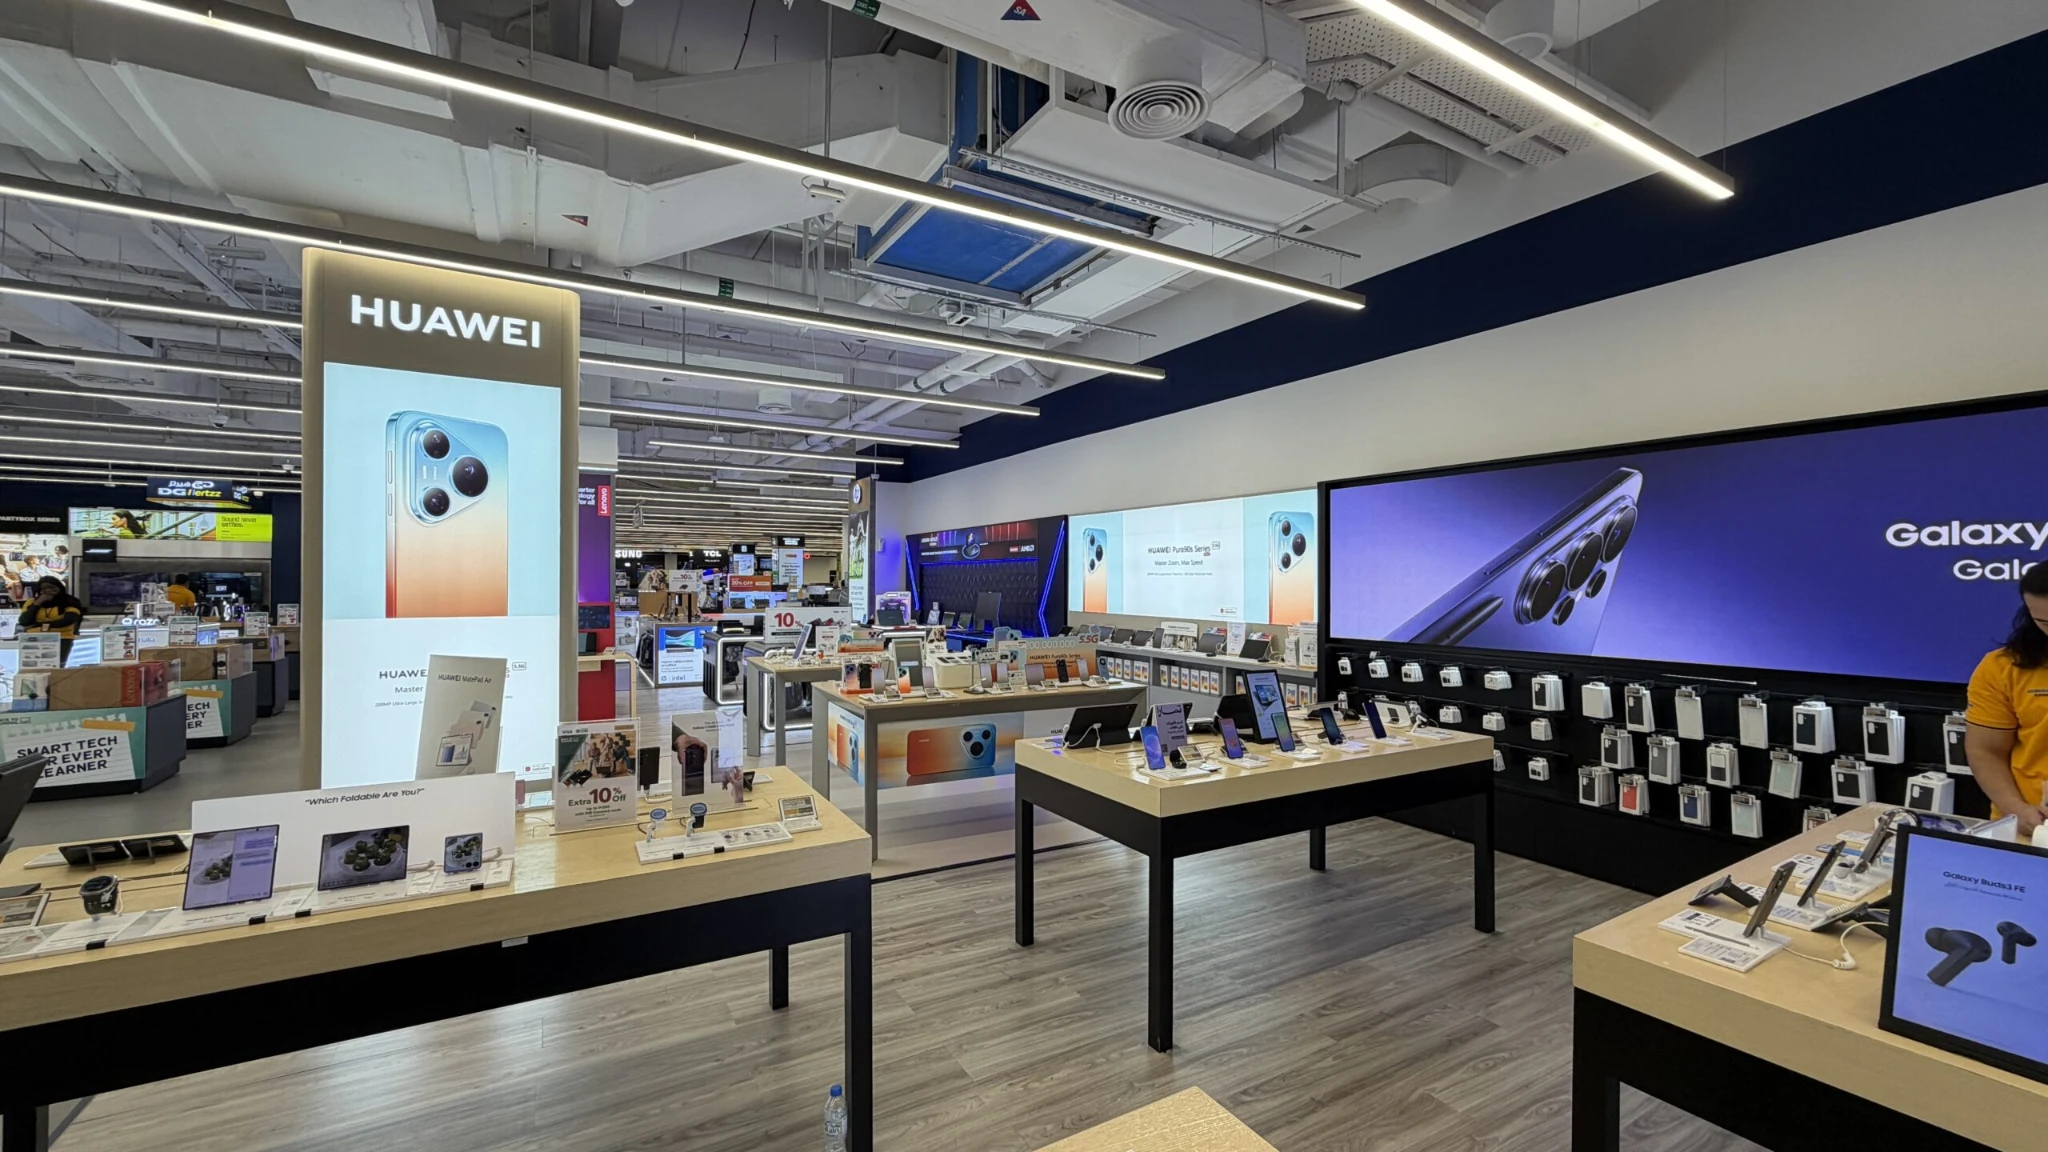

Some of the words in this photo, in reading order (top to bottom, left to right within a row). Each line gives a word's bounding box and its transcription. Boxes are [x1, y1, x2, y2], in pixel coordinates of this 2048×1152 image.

[351, 294, 541, 349] HUAWEI
[157, 487, 187, 496] DG
[600, 487, 608, 514] Lenovo
[1885, 520, 2048, 551] Galaxy
[1148, 546, 1171, 554] HUAWEI
[774, 612, 795, 628] 10
[438, 673, 461, 682] HUAWEI
[395, 685, 424, 694] Master
[17, 742, 72, 759] SMART
[76, 735, 118, 750] TECH
[62, 747, 113, 764] EVERY
[340, 793, 381, 803] Foldable
[382, 790, 399, 799] Are
[568, 799, 591, 807] Extra
[589, 787, 612, 804] 10
[612, 794, 627, 802] Off
[1943, 871, 1980, 885] Galaxy
[1981, 878, 2012, 891] Buds3
[2014, 885, 2026, 894] FE
